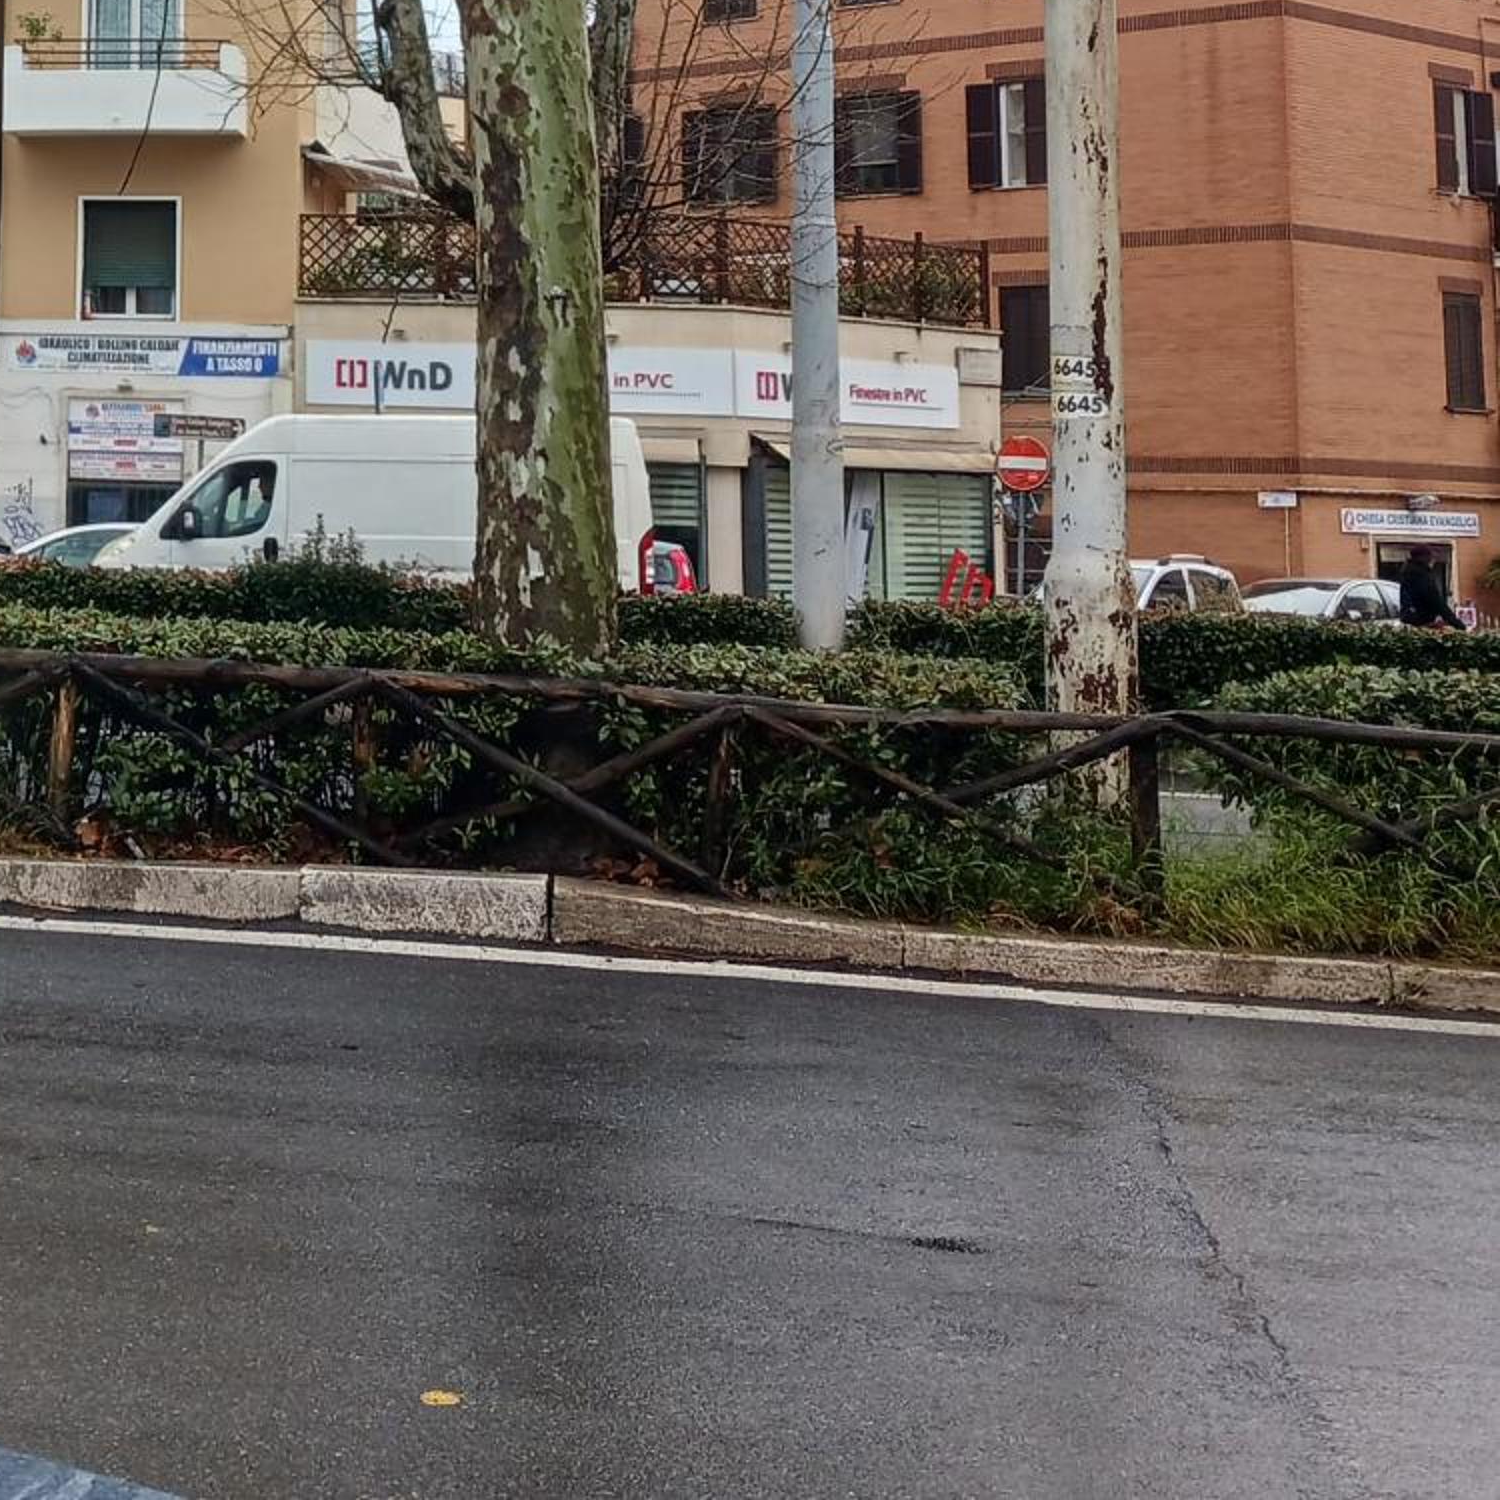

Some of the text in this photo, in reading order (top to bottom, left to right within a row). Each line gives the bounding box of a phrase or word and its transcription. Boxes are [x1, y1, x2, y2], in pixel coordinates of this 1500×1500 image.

[205, 357, 215, 372] A
[217, 357, 252, 372] TASSO
[1054, 358, 1097, 378] 6645
[374, 360, 453, 390] WnD
[613, 373, 675, 389] in PVC
[904, 388, 927, 403] PVC
[1057, 395, 1103, 414] 6645
[1429, 515, 1477, 527] EVANGELICA
